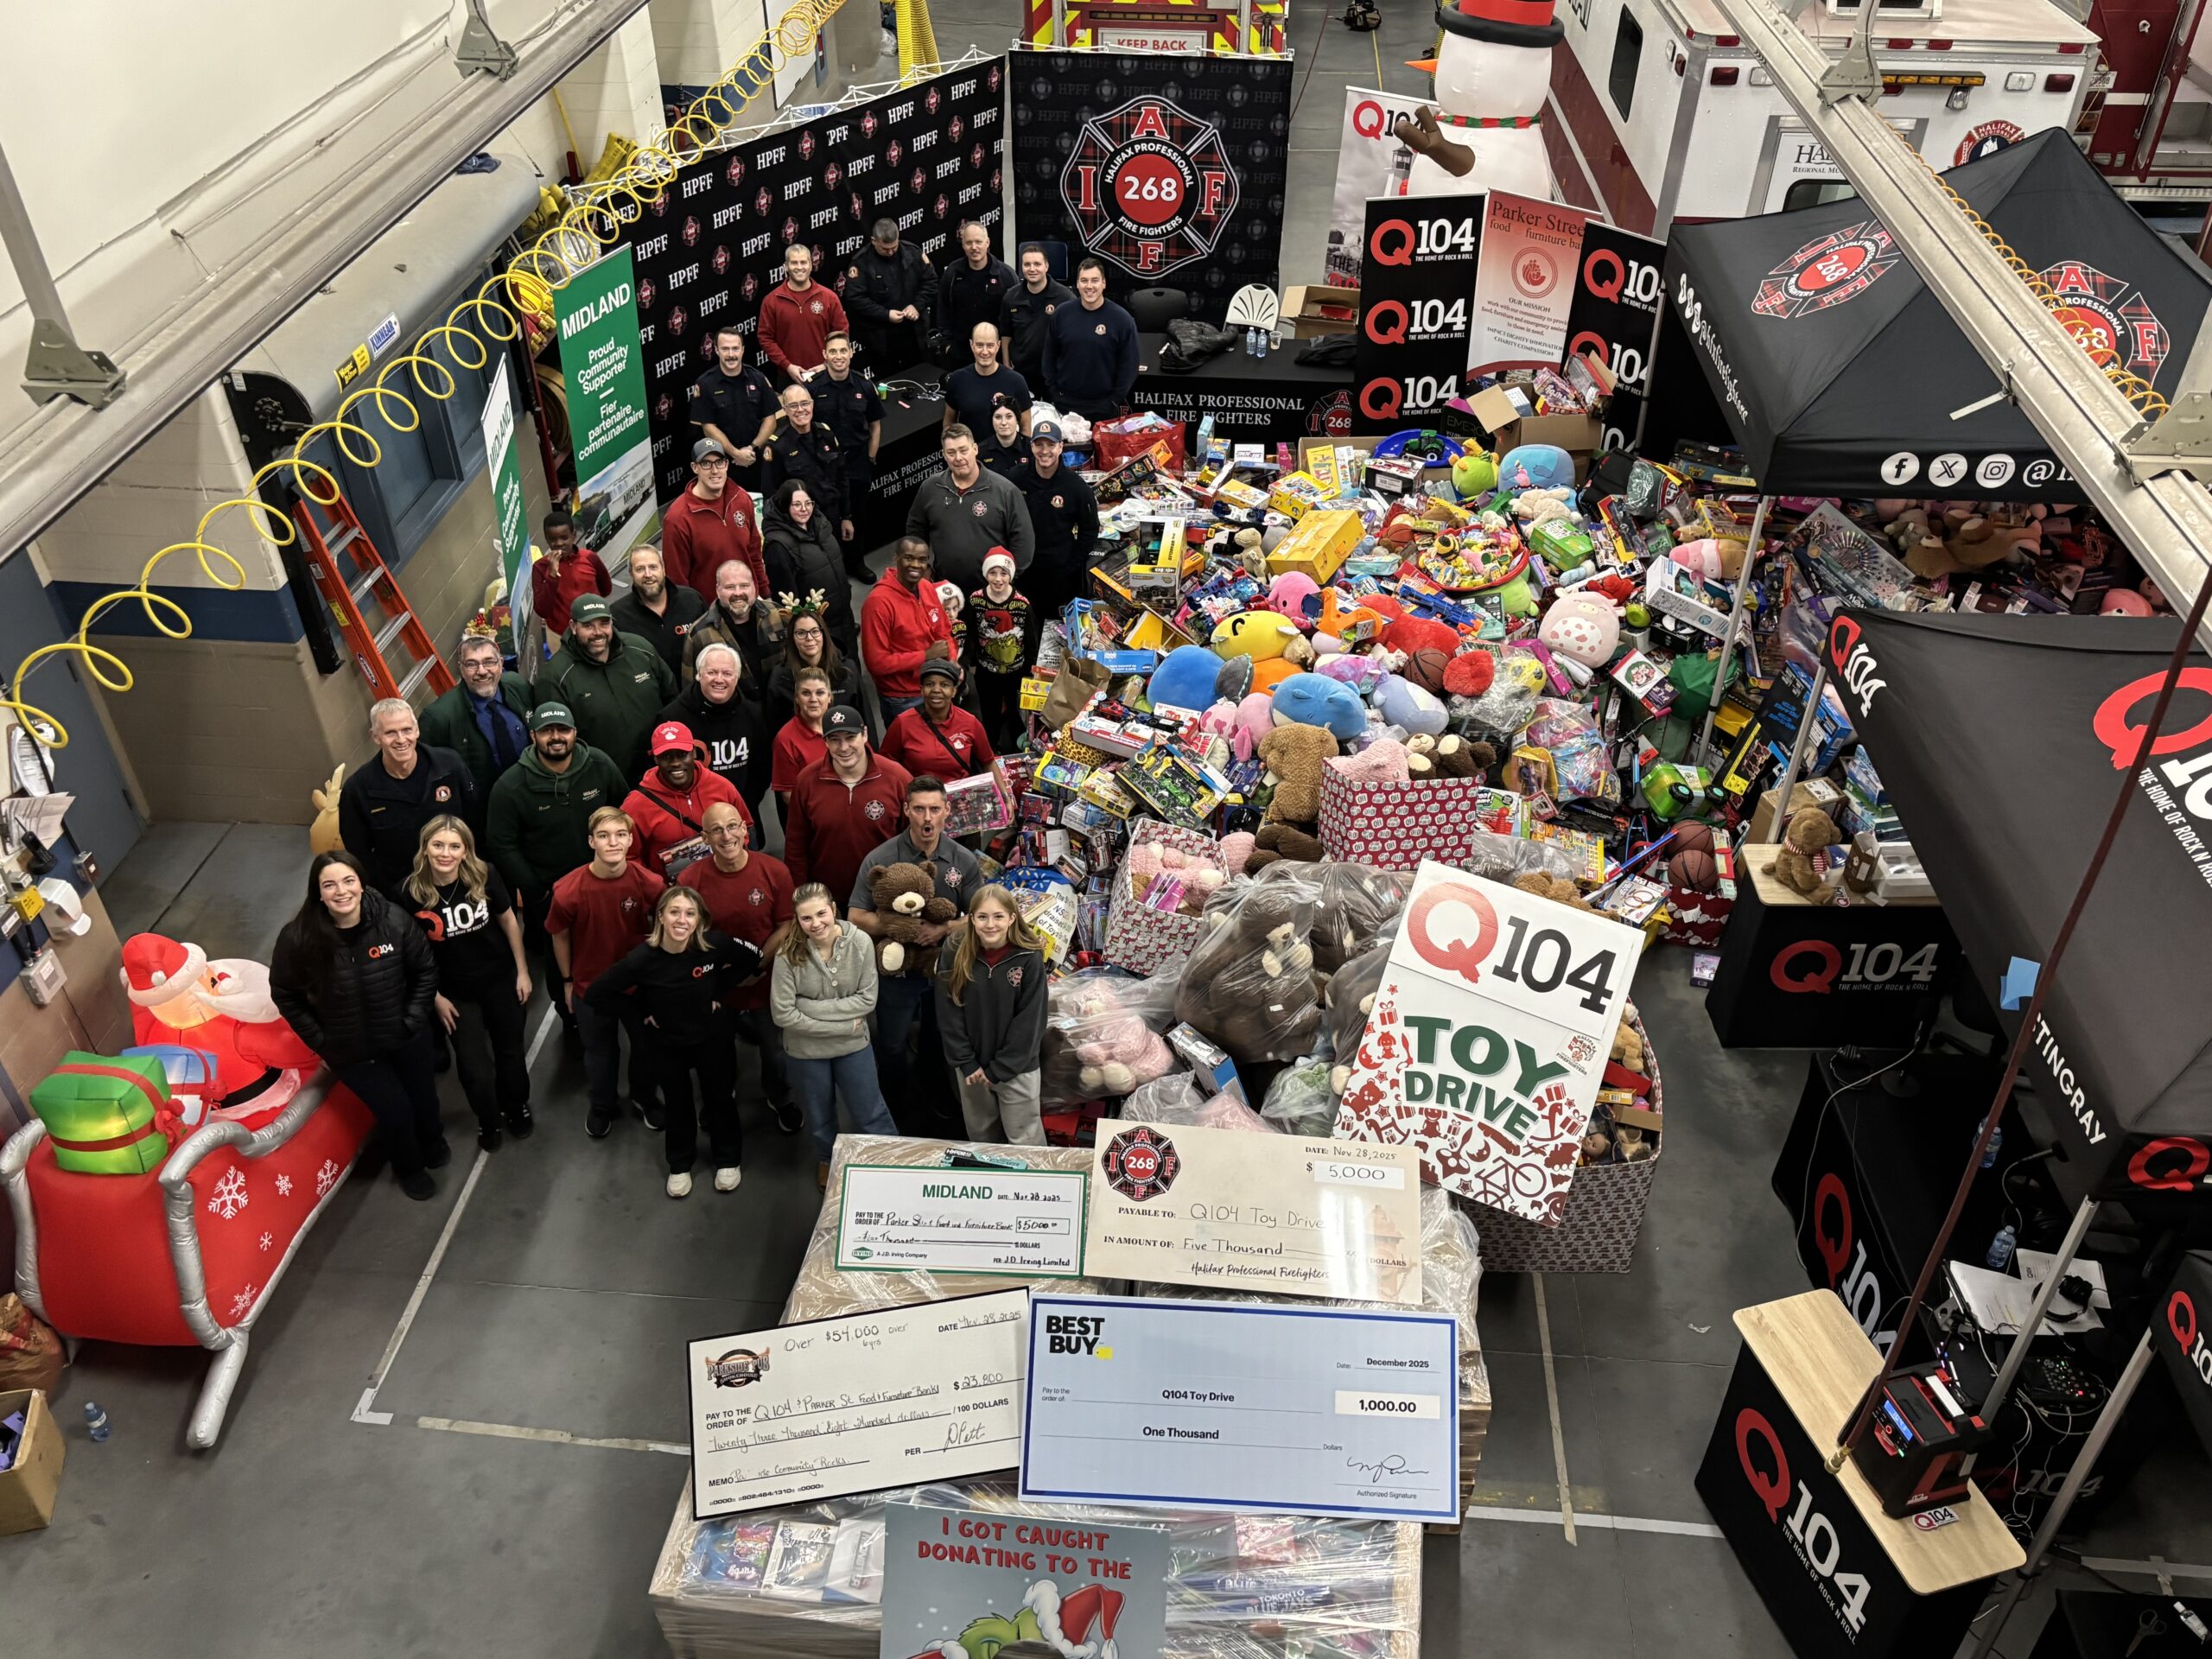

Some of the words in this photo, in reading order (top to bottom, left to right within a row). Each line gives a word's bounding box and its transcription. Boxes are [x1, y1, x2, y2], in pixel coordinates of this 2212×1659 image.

[1117, 39, 1147, 50] KEEP
[1153, 40, 1187, 51] BACK
[951, 79, 976, 100] HPFF
[974, 107, 998, 128] HPFF
[1131, 106, 1170, 140] A
[1979, 123, 2016, 135] HALIFAX
[757, 146, 786, 170] HPFF
[936, 157, 961, 179] HPFF
[1104, 149, 1135, 183] HALIFAX
[1134, 143, 1194, 188] PROFESSIONAL
[784, 176, 812, 200] HPFF
[958, 182, 982, 205] HPFF
[1078, 166, 1096, 209] I
[1124, 175, 1178, 202] 268
[1201, 171, 1225, 215] F
[810, 206, 838, 229] HPFF
[1118, 216, 1138, 233] FIRE
[1139, 215, 1183, 236] FIGHTERS
[1490, 219, 1511, 232] food
[1492, 201, 1541, 226] Parker
[1546, 214, 1586, 238] Stree
[636, 233, 668, 262] HPFF
[742, 232, 771, 257] HPFF
[1370, 218, 1475, 266] Q104
[1525, 228, 1567, 246] furniture
[1137, 241, 1162, 269] F
[1816, 254, 1849, 282] 268
[2054, 266, 2094, 295] A
[562, 283, 631, 340] MIDLAND
[700, 290, 728, 317] HPFF
[1523, 301, 1551, 313] MISSION
[1365, 298, 1467, 344] Q104
[370, 320, 395, 351] KINNEAR
[2133, 322, 2158, 361] F
[588, 337, 615, 364] Proud
[577, 344, 629, 384] Community
[582, 359, 627, 396] Supporter
[600, 400, 618, 418] Fier
[1135, 391, 1194, 406] HALIFAX
[1198, 394, 1305, 410] PROFESSIONAL
[1359, 375, 1459, 420] Q104
[588, 404, 632, 443] partenaire
[1166, 409, 1197, 423] FIRE
[1328, 417, 1352, 429] 268
[489, 400, 512, 476] MIDLAND
[578, 409, 645, 461] communautaire
[623, 477, 646, 505] MIDLAND
[883, 482, 902, 498] FIRE
[905, 462, 944, 494] FIGHTERS
[1831, 615, 1887, 718] Q104
[541, 710, 566, 719] MIDLAND
[2139, 767, 2158, 787] THE
[2145, 784, 2177, 813] HOME
[2164, 811, 2187, 824] OF
[2173, 825, 2205, 854] ROCK
[2191, 851, 2211, 862] N
[368, 943, 394, 958] Q104
[1407, 881, 1618, 1015] Q104
[1770, 939, 1939, 994] Q104
[1403, 1015, 1570, 1099] TOY
[1403, 1071, 1539, 1141] DRIVE
[1128, 1156, 1155, 1170] 268
[1333, 1146, 1351, 1157] Nov
[1329, 1164, 1385, 1180] 5,000
[922, 1184, 993, 1199] MIDLAND
[1118, 1207, 1160, 1217] PAYABLE
[1190, 1203, 1239, 1223] Q104
[1249, 1207, 1277, 1228] Toy
[1116, 1236, 1159, 1248] AMOUNT
[1160, 1239, 1174, 1249] OF:
[1183, 1237, 1208, 1251] Five
[1211, 1238, 1283, 1255] Thousand
[1043, 1257, 1070, 1266] Limited
[1192, 1262, 1224, 1276] Halifax
[1226, 1262, 1276, 1277] Professional
[1280, 1266, 1329, 1281] Firefighters
[785, 1338, 814, 1351] Over
[888, 1323, 908, 1333] over
[938, 1323, 958, 1332] DATE
[1046, 1315, 1105, 1336] BEST
[1049, 1335, 1100, 1356] BUY
[708, 1360, 750, 1380] PARKSIDE
[753, 1355, 770, 1371] PUB
[1366, 1357, 1408, 1368] December
[1408, 1359, 1429, 1368] 2025
[972, 1398, 1009, 1411] DOLLARS
[1162, 1389, 1188, 1400] Q104
[1190, 1391, 1207, 1402] Toy
[1209, 1392, 1235, 1402] Drive
[1358, 1399, 1417, 1413] 1,000.00
[706, 1412, 721, 1421] PAY
[735, 1408, 752, 1416] THE
[706, 1420, 734, 1430] ORDER
[736, 1418, 748, 1427] OF
[1142, 1427, 1165, 1437] One
[1167, 1427, 1219, 1440] Thousand
[905, 1447, 921, 1457] PER
[709, 1477, 734, 1487] MEMO
[1389, 1491, 1417, 1500] Signature
[1736, 1408, 1872, 1634] Q104
[1913, 1507, 1955, 1529] Q104
[942, 1517, 950, 1535] I
[958, 1519, 1007, 1541] GOT
[1015, 1525, 1109, 1551] CAUGHT
[918, 1541, 1037, 1571] DONATING
[1046, 1554, 1077, 1574] TO
[1087, 1558, 1133, 1580] THE
[1783, 1522, 1794, 1544] THE
[1794, 1542, 1810, 1570] HOME
[1809, 1568, 1819, 1582] OF
[1818, 1582, 1835, 1611] ROCK
[1840, 1618, 1856, 1645] ROLL
